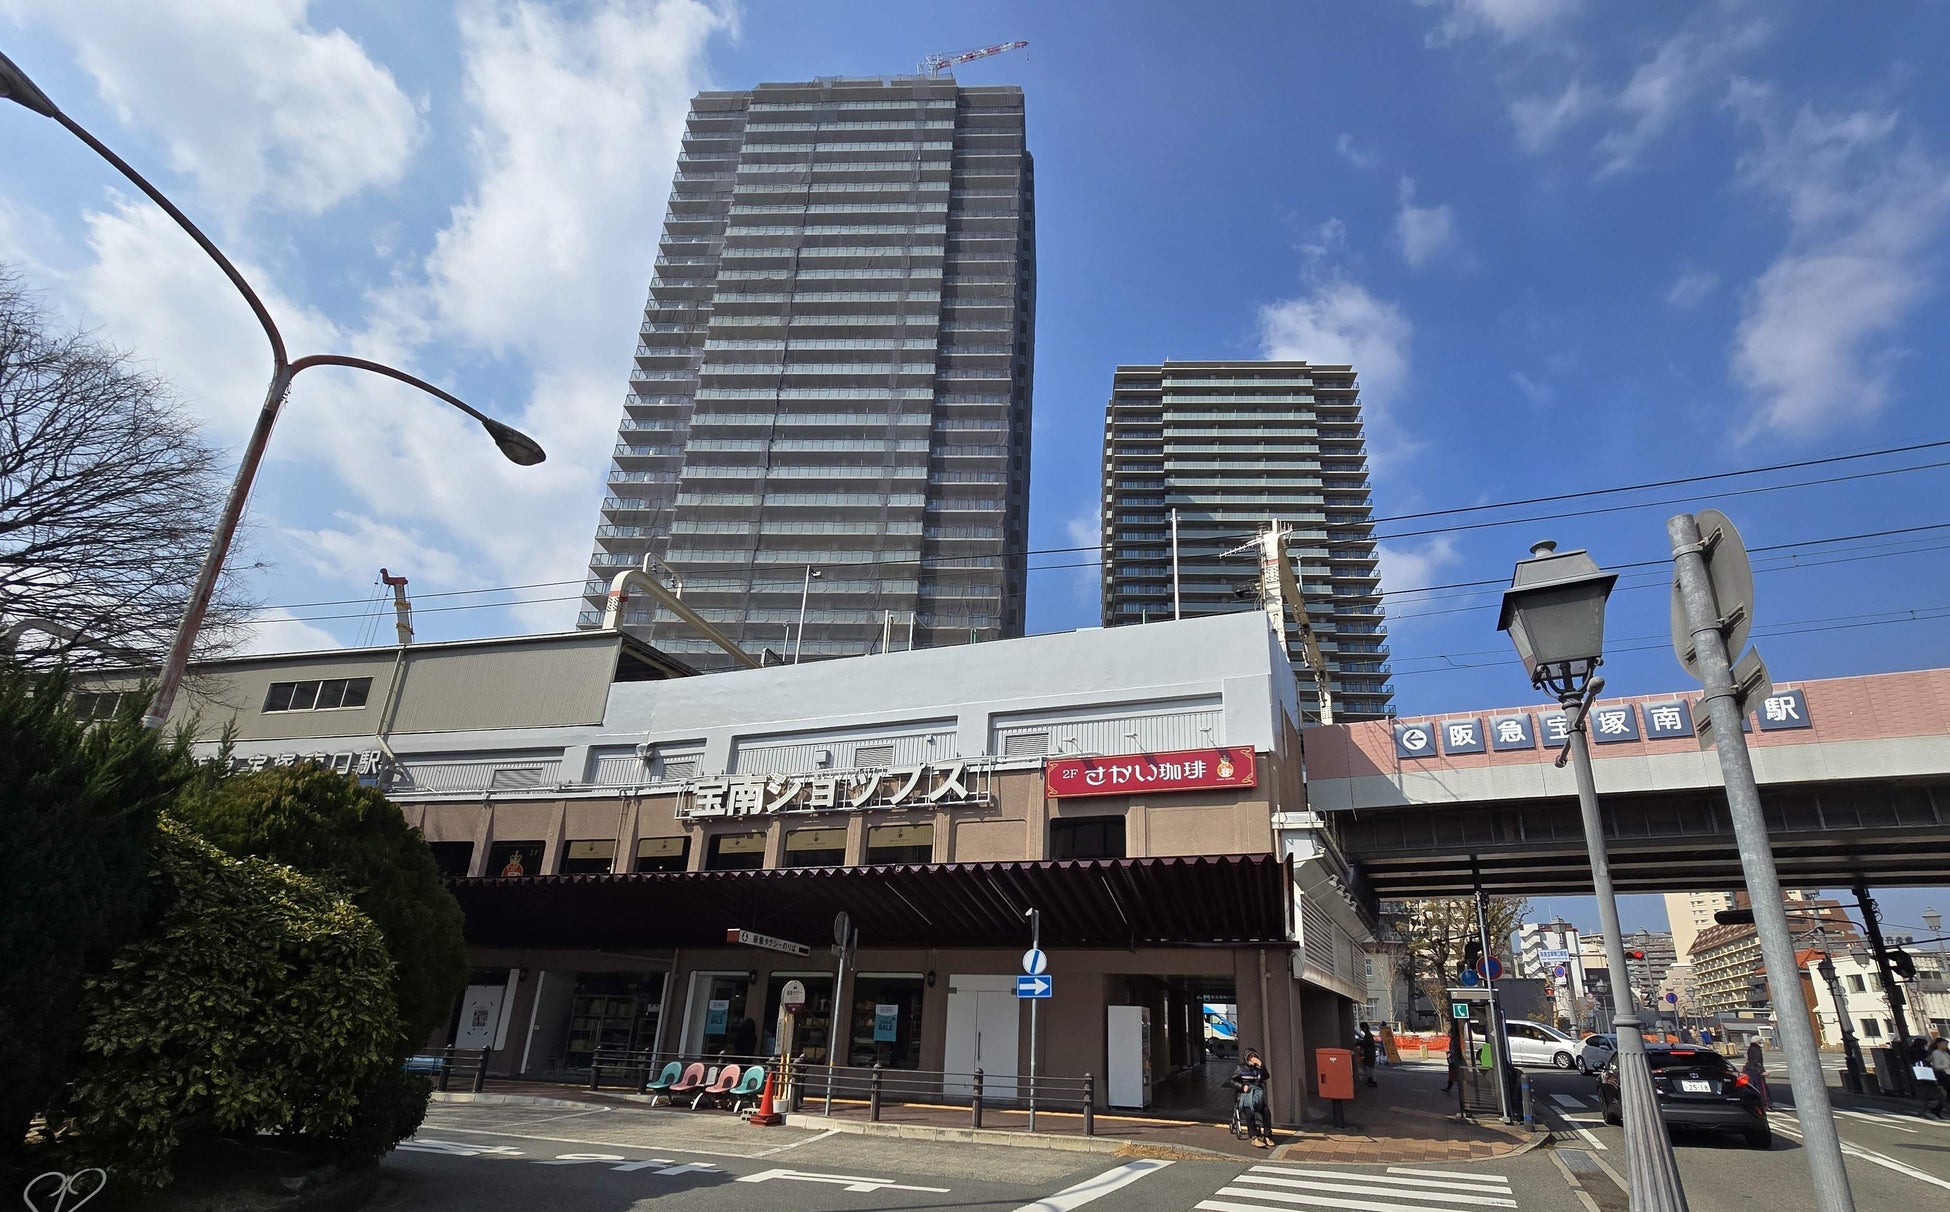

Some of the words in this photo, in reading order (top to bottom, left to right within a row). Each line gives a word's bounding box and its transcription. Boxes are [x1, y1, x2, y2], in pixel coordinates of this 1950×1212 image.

[1450, 697, 1799, 746] 阪急宝塚南駅
[689, 760, 969, 816] 宝南ショップス
[1062, 769, 1079, 779] 2F
[1084, 760, 1207, 785] さかい珈琲
